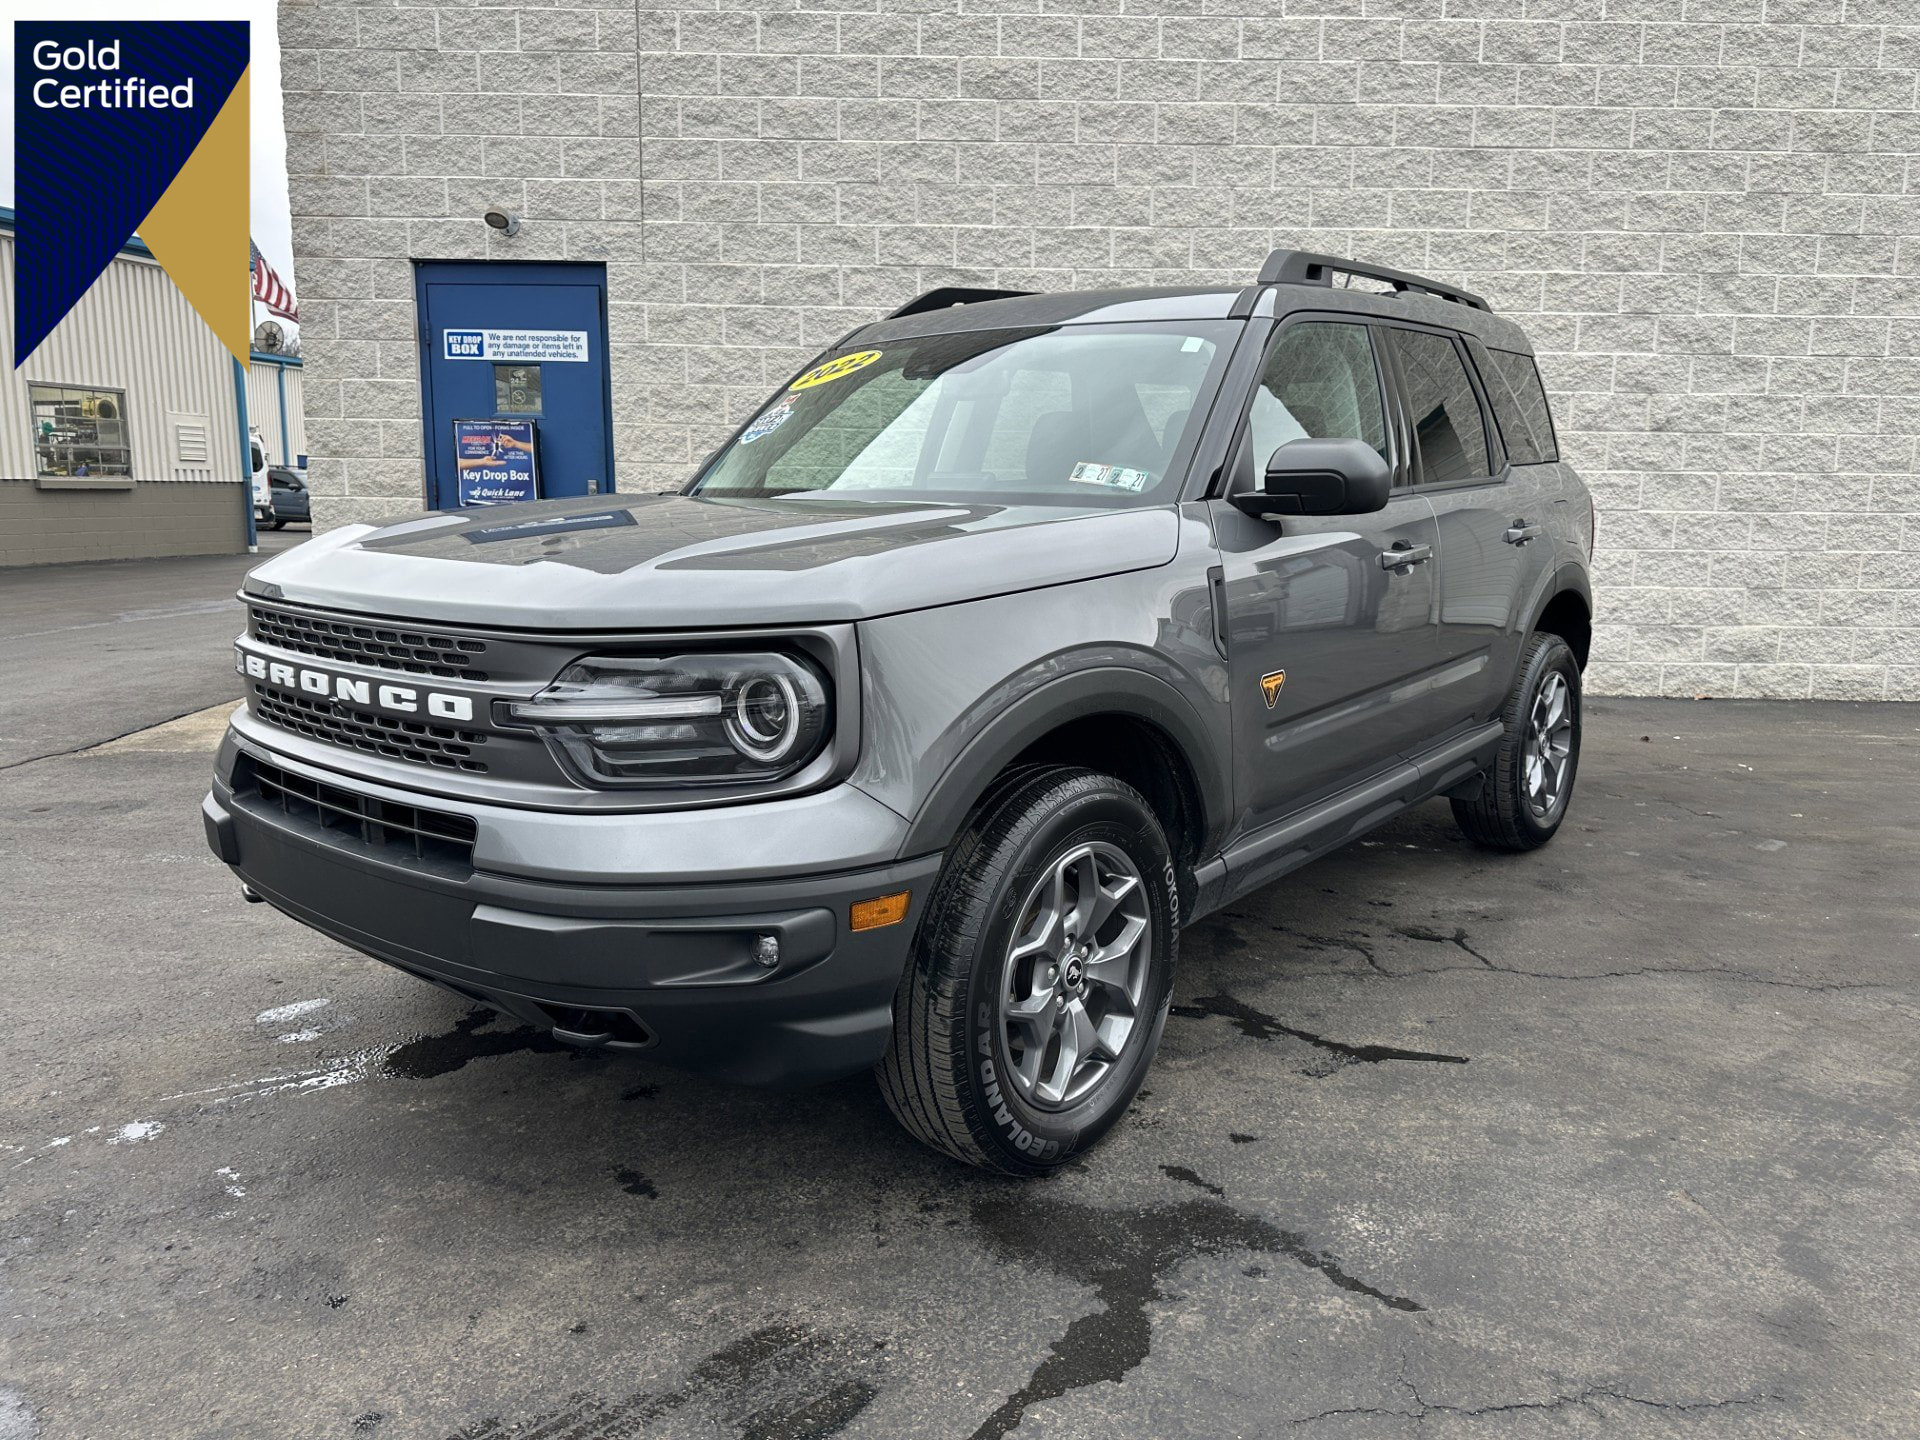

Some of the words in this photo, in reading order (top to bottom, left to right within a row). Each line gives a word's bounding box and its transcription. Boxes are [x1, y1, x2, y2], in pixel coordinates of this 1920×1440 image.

[448, 335, 462, 344] KEY
[463, 335, 482, 344] DROP
[489, 333, 501, 341] We
[528, 334, 569, 343] responsible
[570, 334, 581, 342] for
[451, 343, 480, 355] BOX
[488, 342, 501, 350] any
[502, 342, 531, 351] damage
[541, 342, 561, 350] items
[492, 350, 505, 358] any
[506, 350, 547, 358] unattended
[547, 351, 579, 359] vehicles.
[795, 352, 877, 387] 2022
[463, 469, 481, 483] Key
[483, 469, 508, 483] Drop
[510, 469, 529, 480] Box
[1073, 466, 1085, 479] 2
[1096, 467, 1109, 481] 27
[1131, 473, 1146, 488] 27
[481, 488, 503, 497] Quick
[504, 488, 526, 497] Lane
[245, 654, 473, 721] BRONCO
[977, 1001, 1060, 1159] GEOLANDAR
